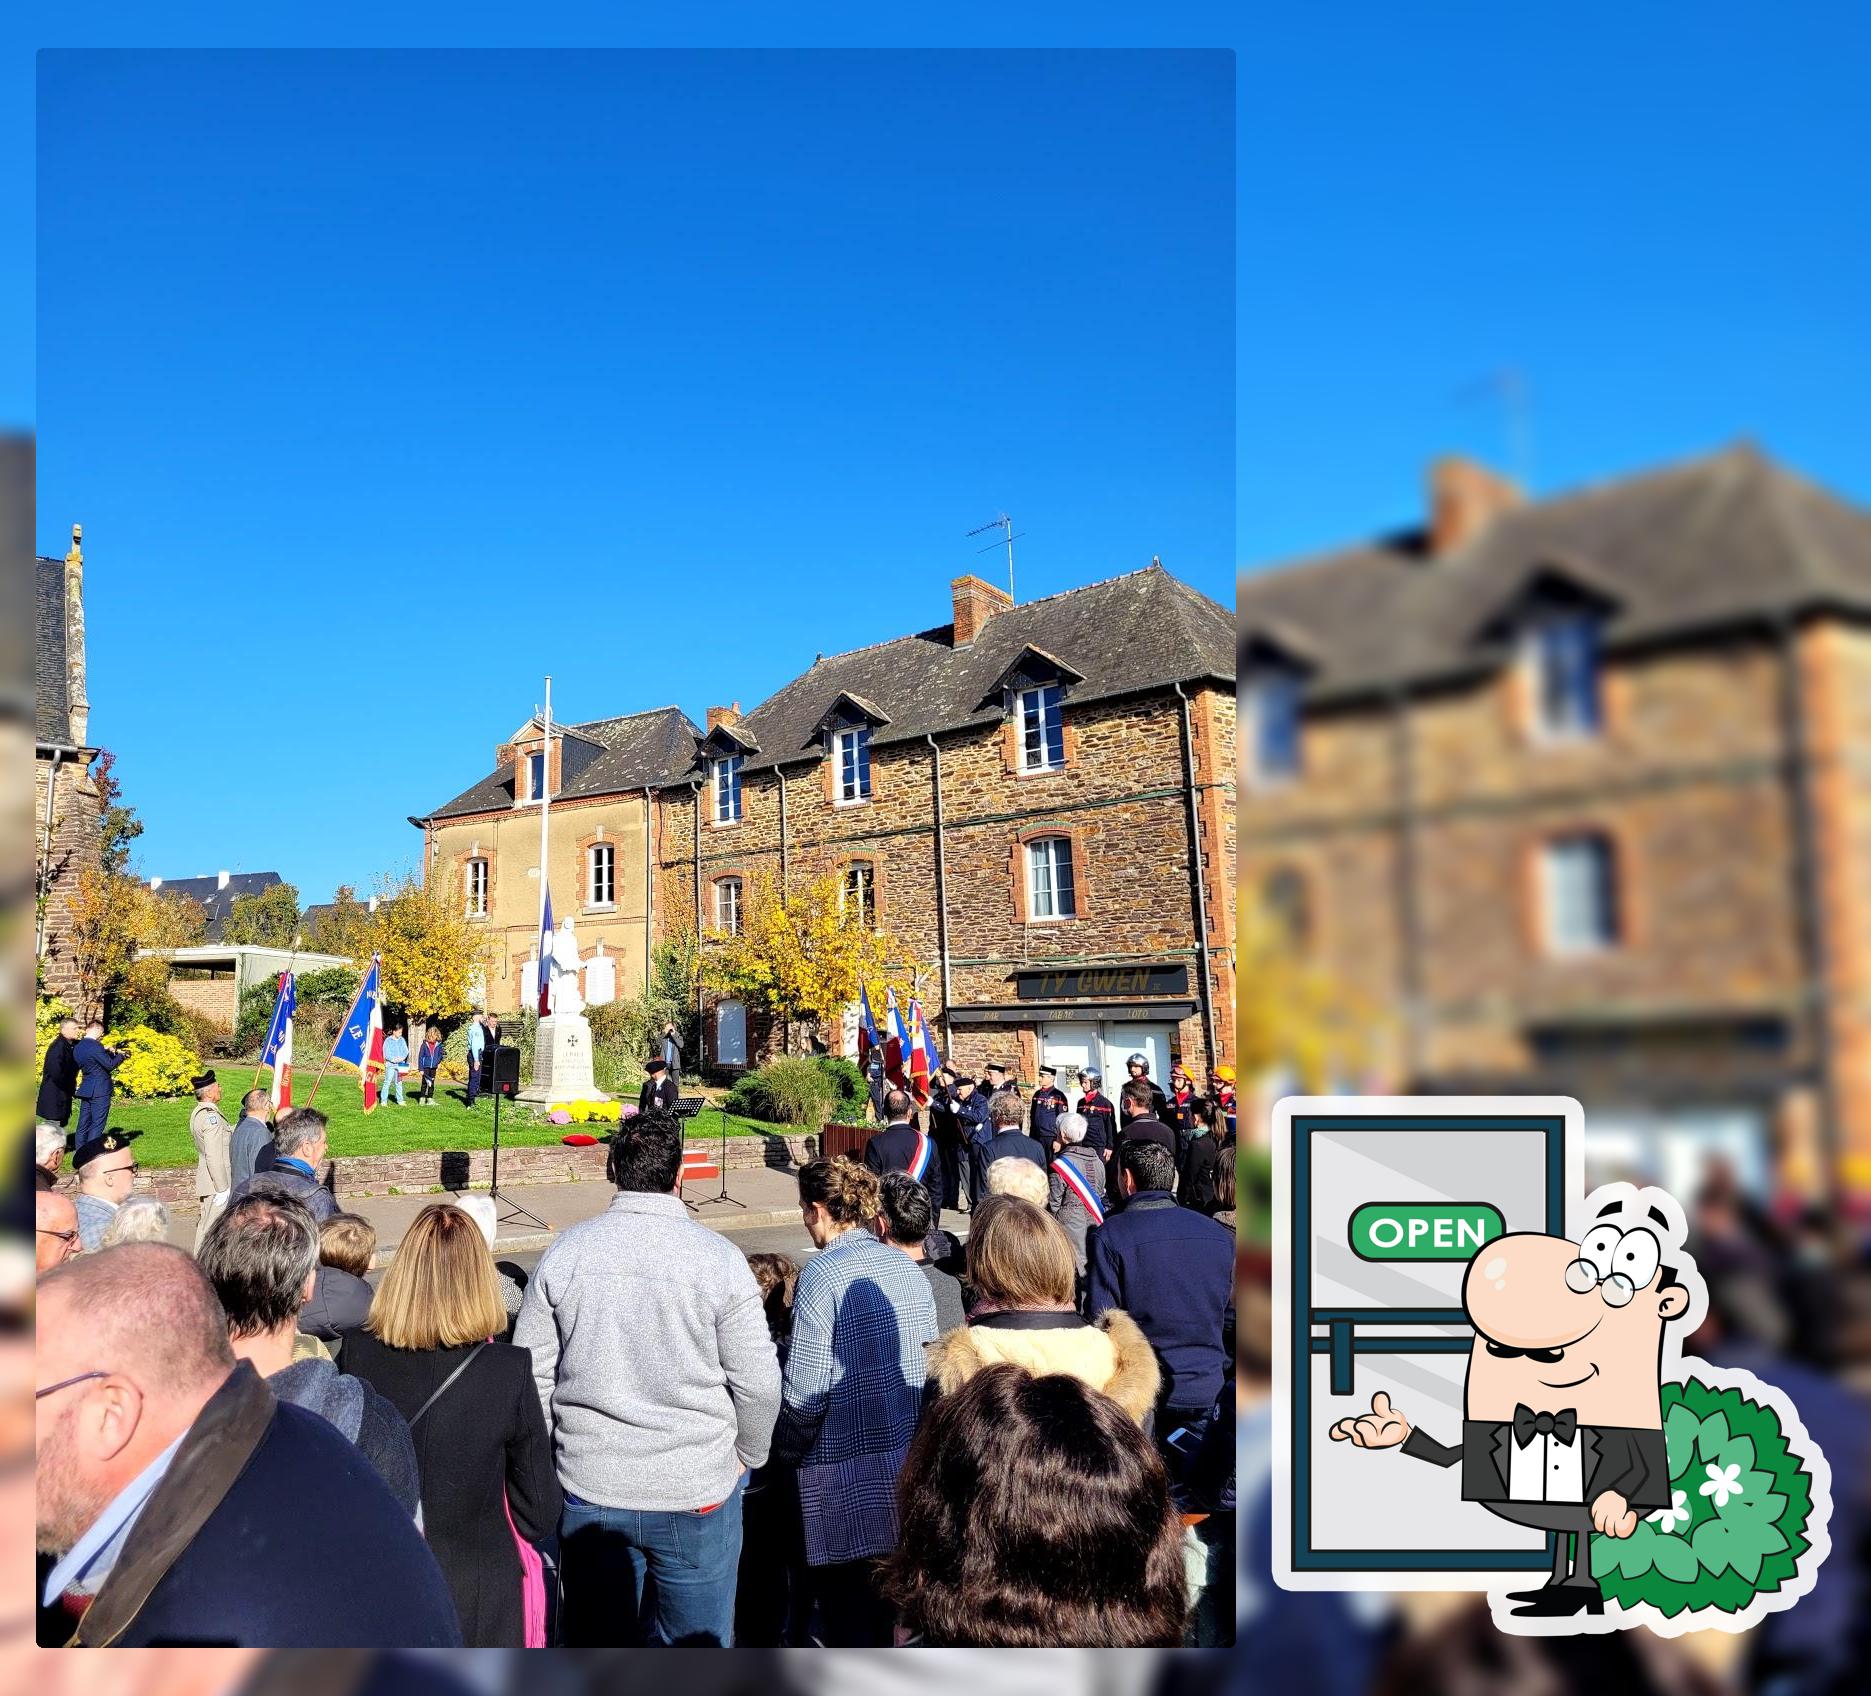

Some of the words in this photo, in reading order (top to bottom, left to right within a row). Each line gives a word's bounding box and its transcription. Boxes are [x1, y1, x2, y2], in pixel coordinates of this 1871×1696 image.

[1039, 971, 1067, 993] TY
[1077, 967, 1150, 993] GWEN
[983, 1010, 1000, 1020] BAR
[1049, 1010, 1073, 1019] TABAC
[1127, 1008, 1149, 1018] LOTO
